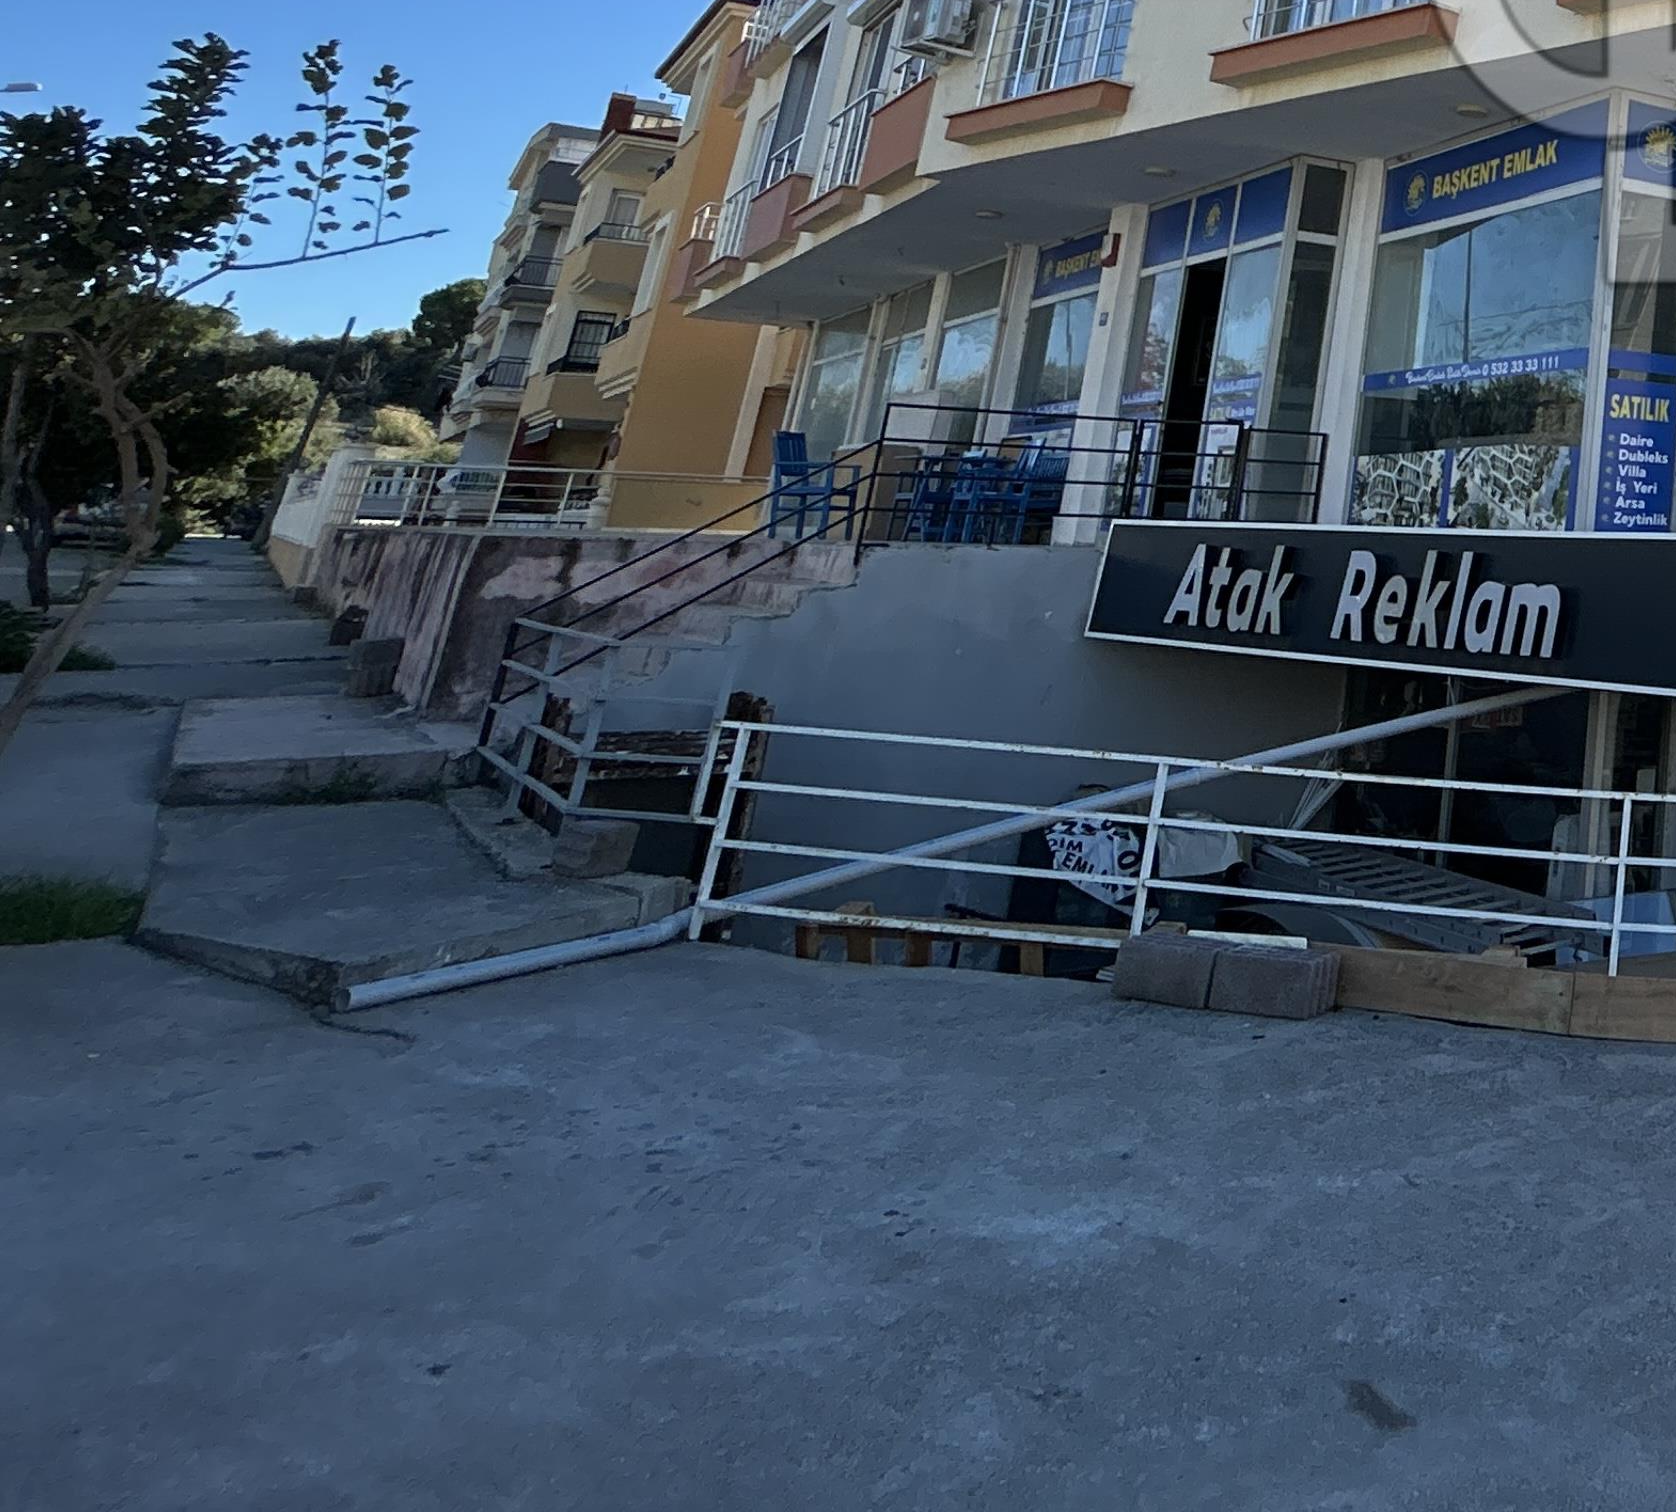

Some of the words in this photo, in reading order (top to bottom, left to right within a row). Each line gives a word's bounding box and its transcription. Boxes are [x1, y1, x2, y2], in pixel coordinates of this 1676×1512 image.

[1432, 157, 1501, 200] BAŞKENT
[1503, 139, 1559, 179] EMLAK
[1481, 363, 1489, 377] 0
[1490, 362, 1509, 376] 532
[1510, 359, 1523, 374] 33
[1525, 358, 1538, 372] 33
[1541, 356, 1560, 371] 111
[1609, 393, 1670, 423] SATILIK
[1620, 432, 1654, 448] Daire
[1618, 448, 1669, 465] Dubleks
[1618, 464, 1647, 478] Villa
[1633, 480, 1658, 495] Yeri
[1615, 495, 1646, 509] Arsa
[1613, 511, 1668, 528] Zeytinlik
[1164, 543, 1294, 637] Atak
[1329, 549, 1562, 659] Reklam
